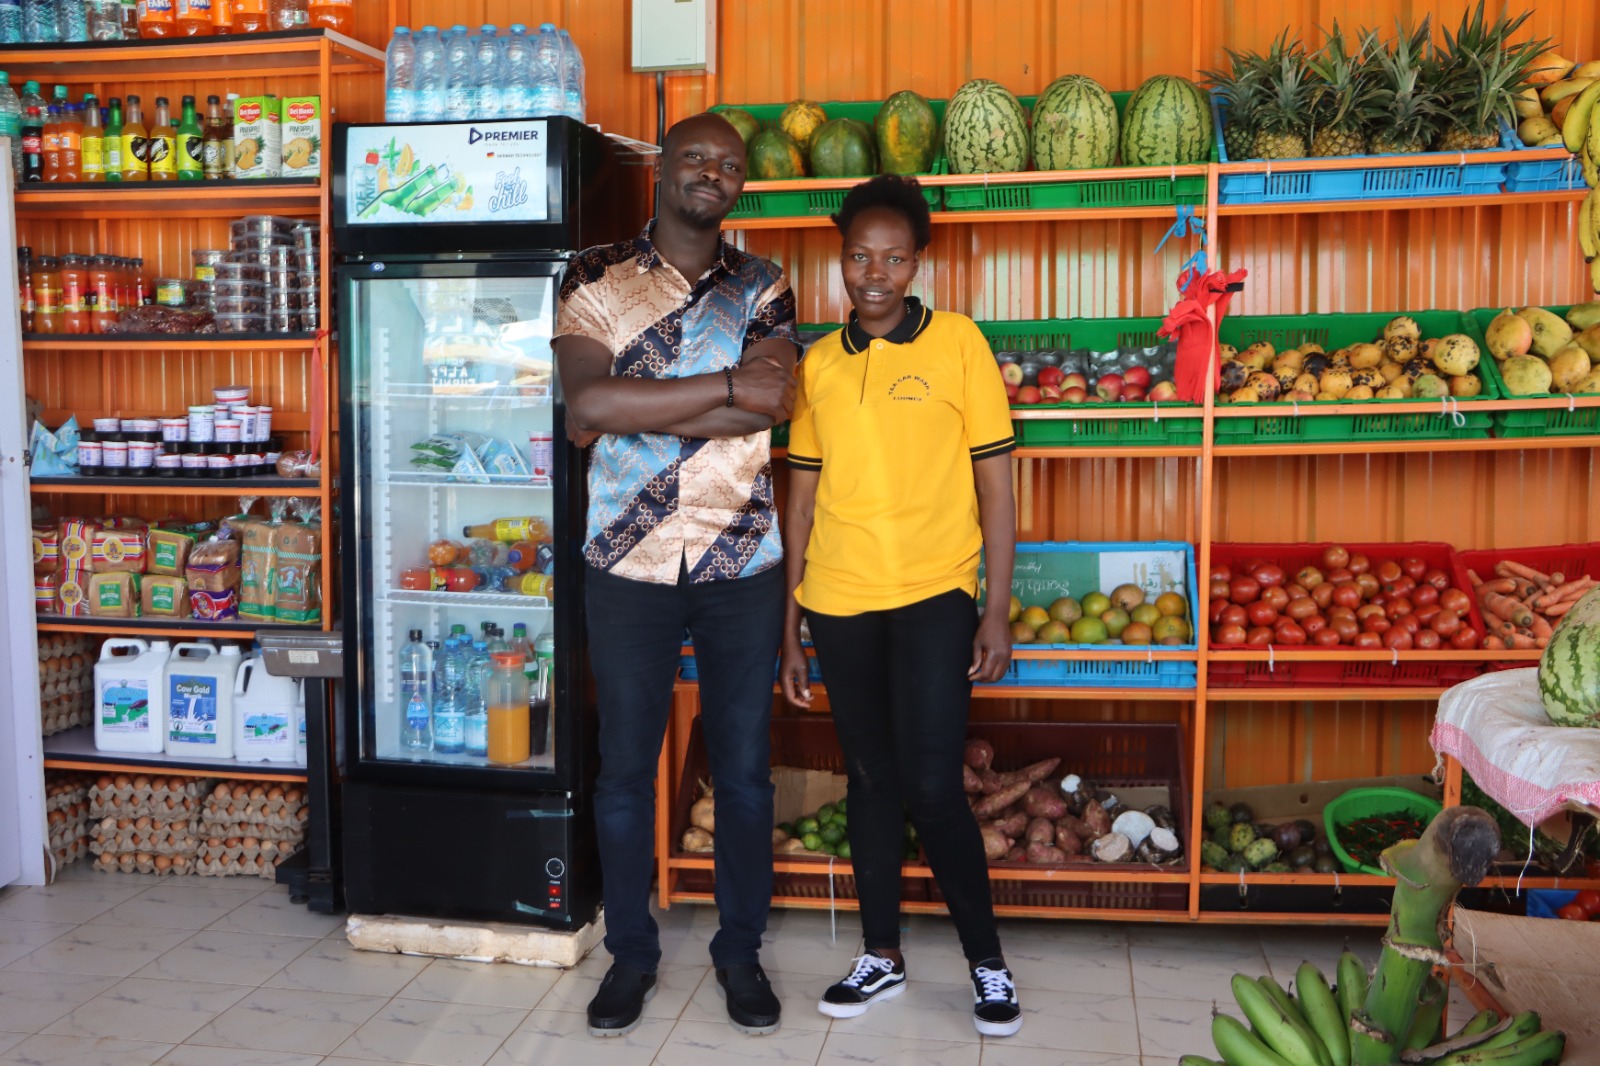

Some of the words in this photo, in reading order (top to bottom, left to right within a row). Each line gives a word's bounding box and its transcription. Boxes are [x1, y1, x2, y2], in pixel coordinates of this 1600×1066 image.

[240, 126, 260, 134] PINEAPPLE
[289, 125, 314, 133] PINEAPPLE
[485, 131, 539, 141] PREMIER
[495, 166, 520, 190] Feel
[488, 180, 528, 212] chill
[176, 684, 192, 693] Cow
[193, 685, 210, 694] Gold
